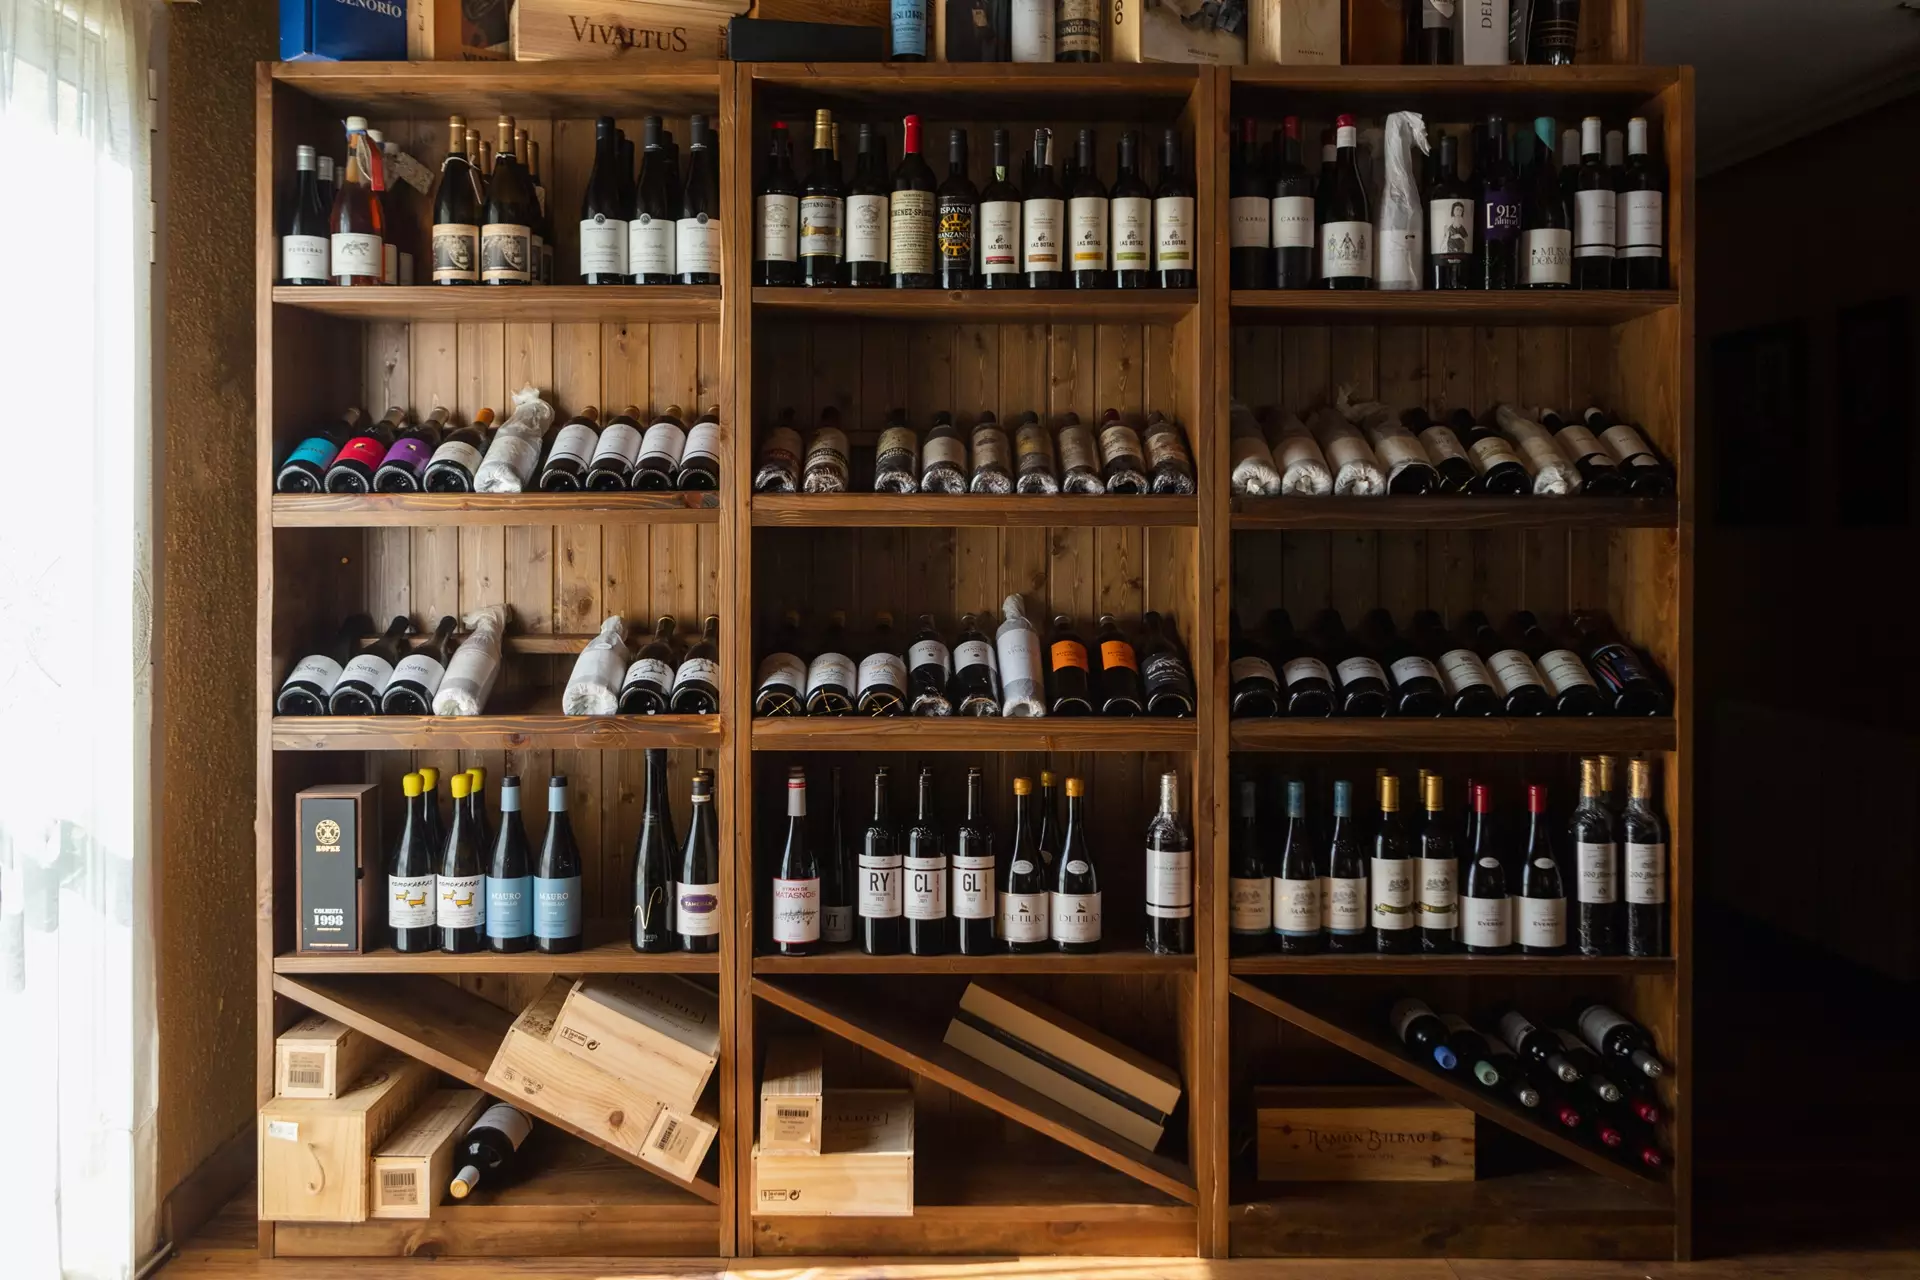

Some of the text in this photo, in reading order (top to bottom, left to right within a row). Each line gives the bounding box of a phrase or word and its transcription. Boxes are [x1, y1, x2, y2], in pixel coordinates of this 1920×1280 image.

[568, 15, 687, 52] VIVALTUS
[869, 872, 890, 892] RY
[914, 873, 933, 893] CL
[962, 873, 981, 892] GL
[491, 892, 522, 900] MAURO
[540, 892, 569, 900] MAURO
[775, 891, 816, 899] MATASNOS
[313, 914, 344, 926] 1998
[1366, 1128, 1426, 1151] BILBAO
